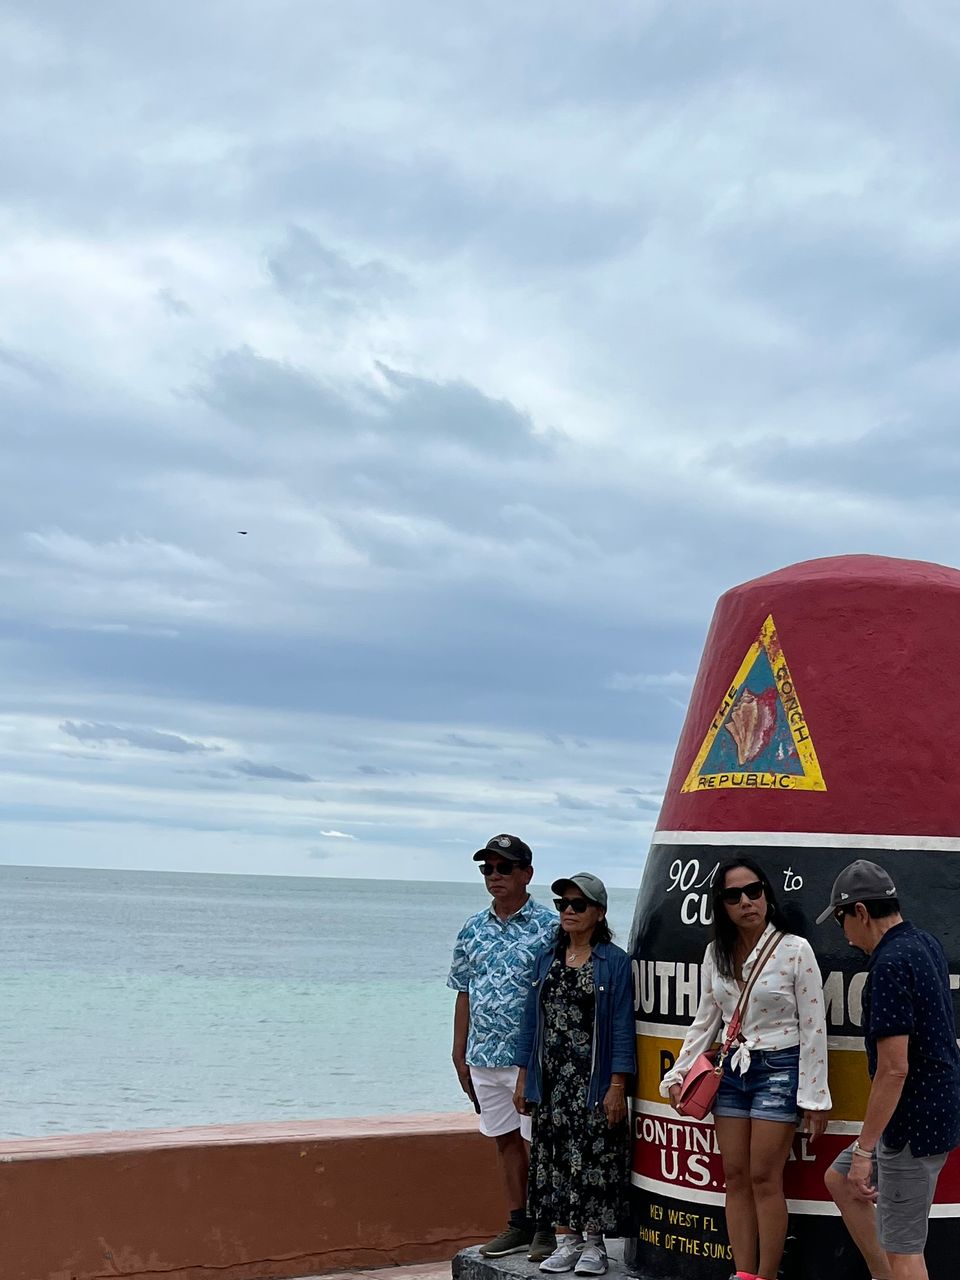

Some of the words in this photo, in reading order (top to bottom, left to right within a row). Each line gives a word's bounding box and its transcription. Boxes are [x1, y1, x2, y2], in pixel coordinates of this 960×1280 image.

[710, 685, 738, 731] THE
[776, 668, 809, 743] CONCH
[697, 773, 791, 788] REPUBLIC
[666, 859, 700, 891] 90
[783, 867, 803, 891] to
[680, 892, 714, 925] CU
[660, 1148, 727, 1188] U.S.
[650, 1204, 663, 1221] KEY
[668, 1209, 699, 1228] WEST
[703, 1217, 718, 1232] FL
[639, 1226, 661, 1247] HOME
[665, 1234, 677, 1249] OF
[677, 1236, 701, 1256] THE
[702, 1242, 733, 1260] SUNS
